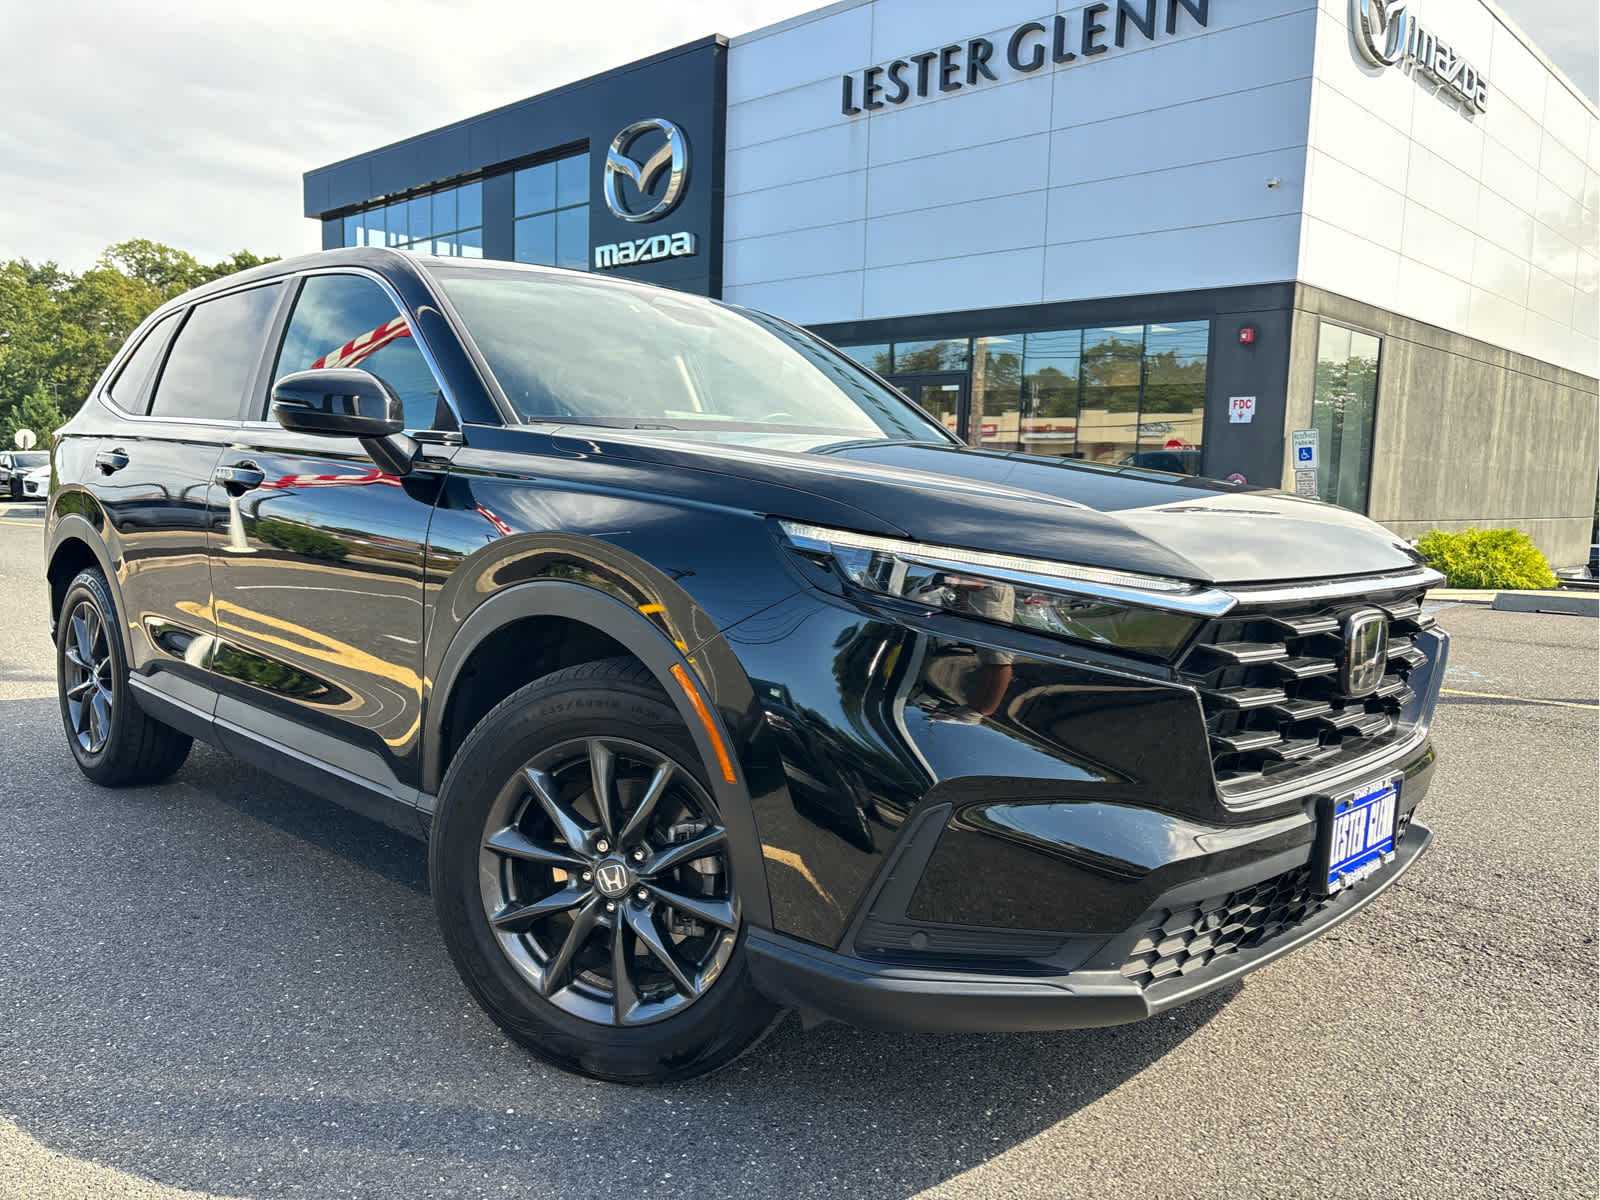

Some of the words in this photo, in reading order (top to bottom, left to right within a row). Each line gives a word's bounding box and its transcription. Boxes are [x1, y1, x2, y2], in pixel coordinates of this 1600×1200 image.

[841, 37, 998, 117] LESTER
[1006, 0, 1209, 73] GLENN
[595, 231, 698, 269] mazda
[1233, 399, 1252, 410] FDC
[1329, 806, 1367, 867] LESTER
